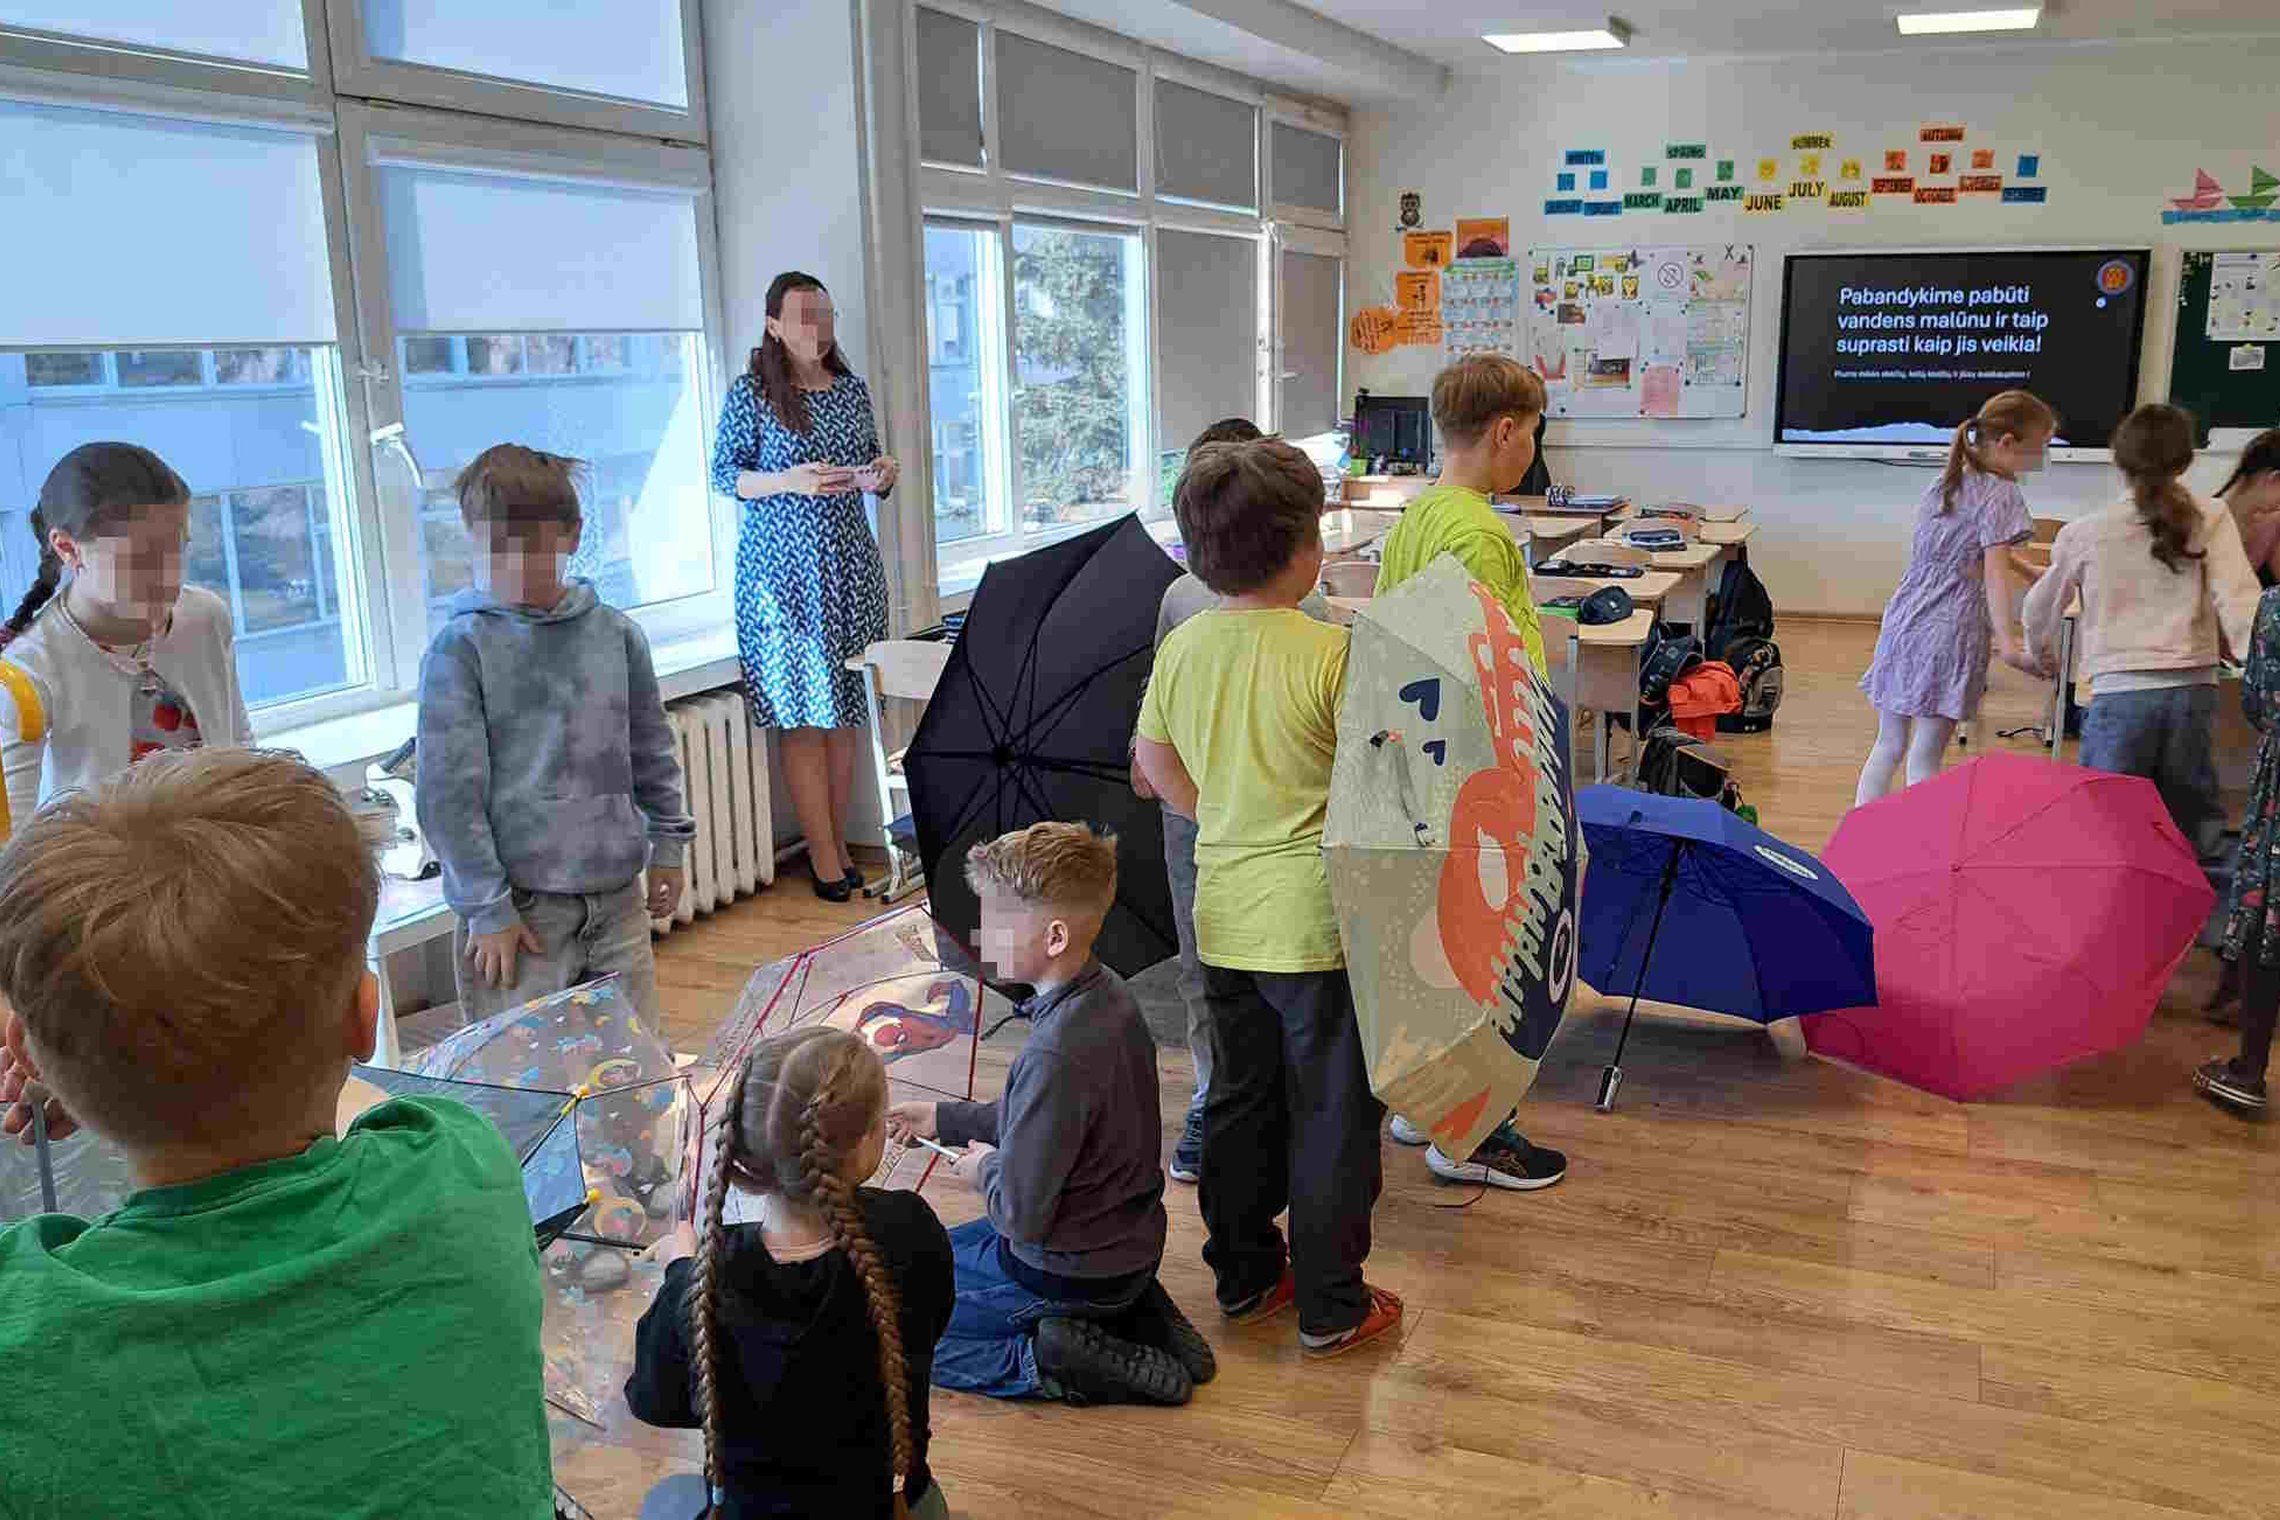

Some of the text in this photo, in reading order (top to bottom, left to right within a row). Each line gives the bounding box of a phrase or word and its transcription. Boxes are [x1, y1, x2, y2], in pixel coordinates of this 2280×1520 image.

[1706, 187, 1739, 201] MAY
[1788, 181, 1825, 198] JULY
[1624, 193, 1661, 209] MARCH
[1664, 197, 1703, 214] APRIL
[1744, 194, 1782, 211] JUNE
[1828, 191, 1868, 208] AUGUST
[1840, 285, 2031, 308] Pabandykime pabūti
[1837, 309, 2050, 331] vandens malūnu ir taip
[1836, 335, 2042, 357] suprasti kaip jis veikia!
